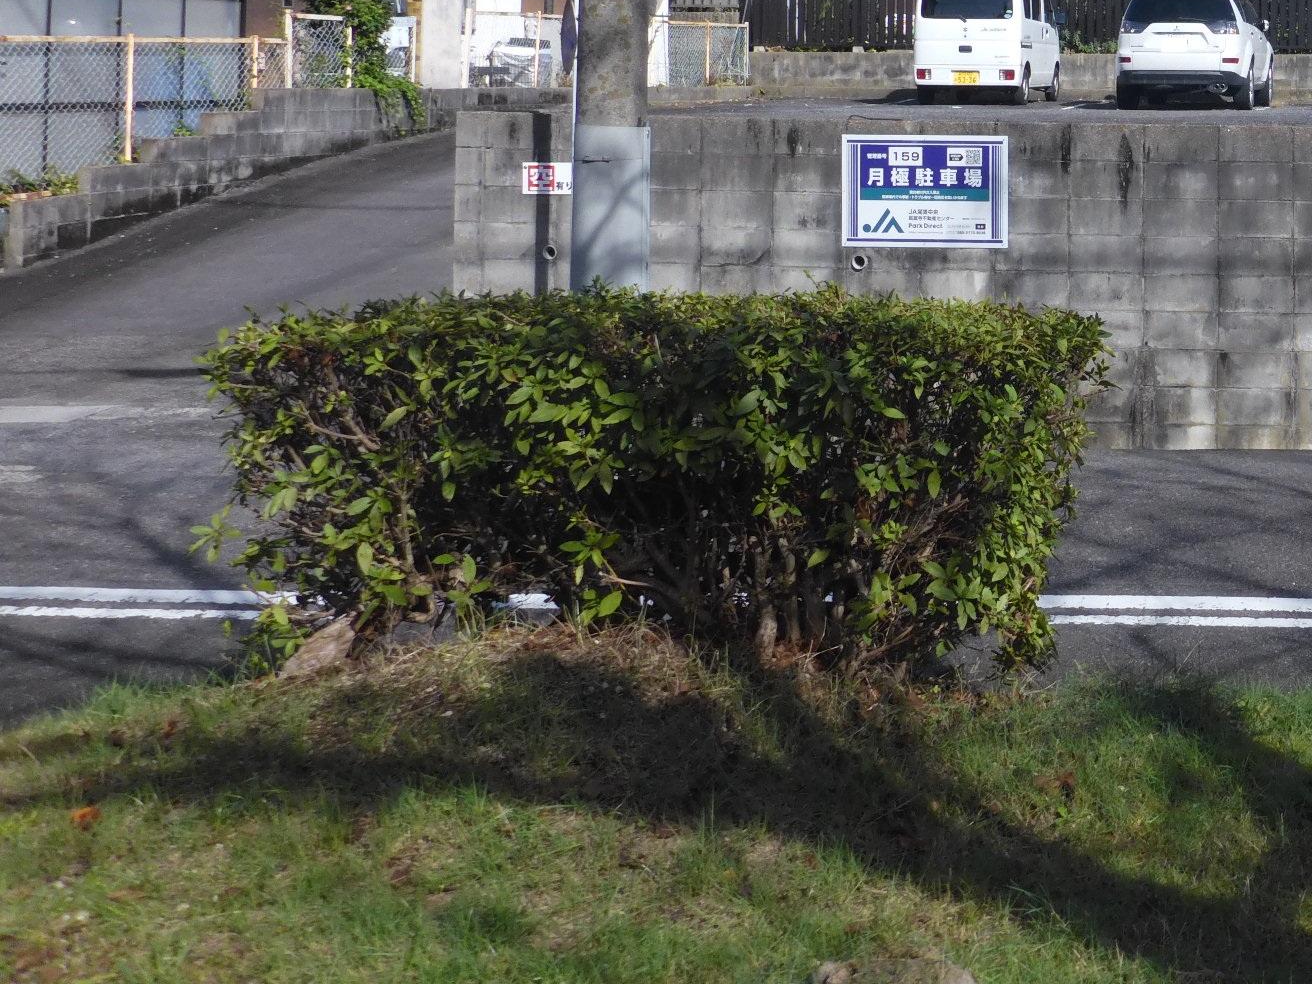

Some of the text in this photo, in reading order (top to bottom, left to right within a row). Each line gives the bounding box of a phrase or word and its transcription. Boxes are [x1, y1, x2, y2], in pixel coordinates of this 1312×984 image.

[893, 151, 920, 162] 159
[528, 165, 555, 191] 空
[867, 167, 983, 188] 月極駐車場
